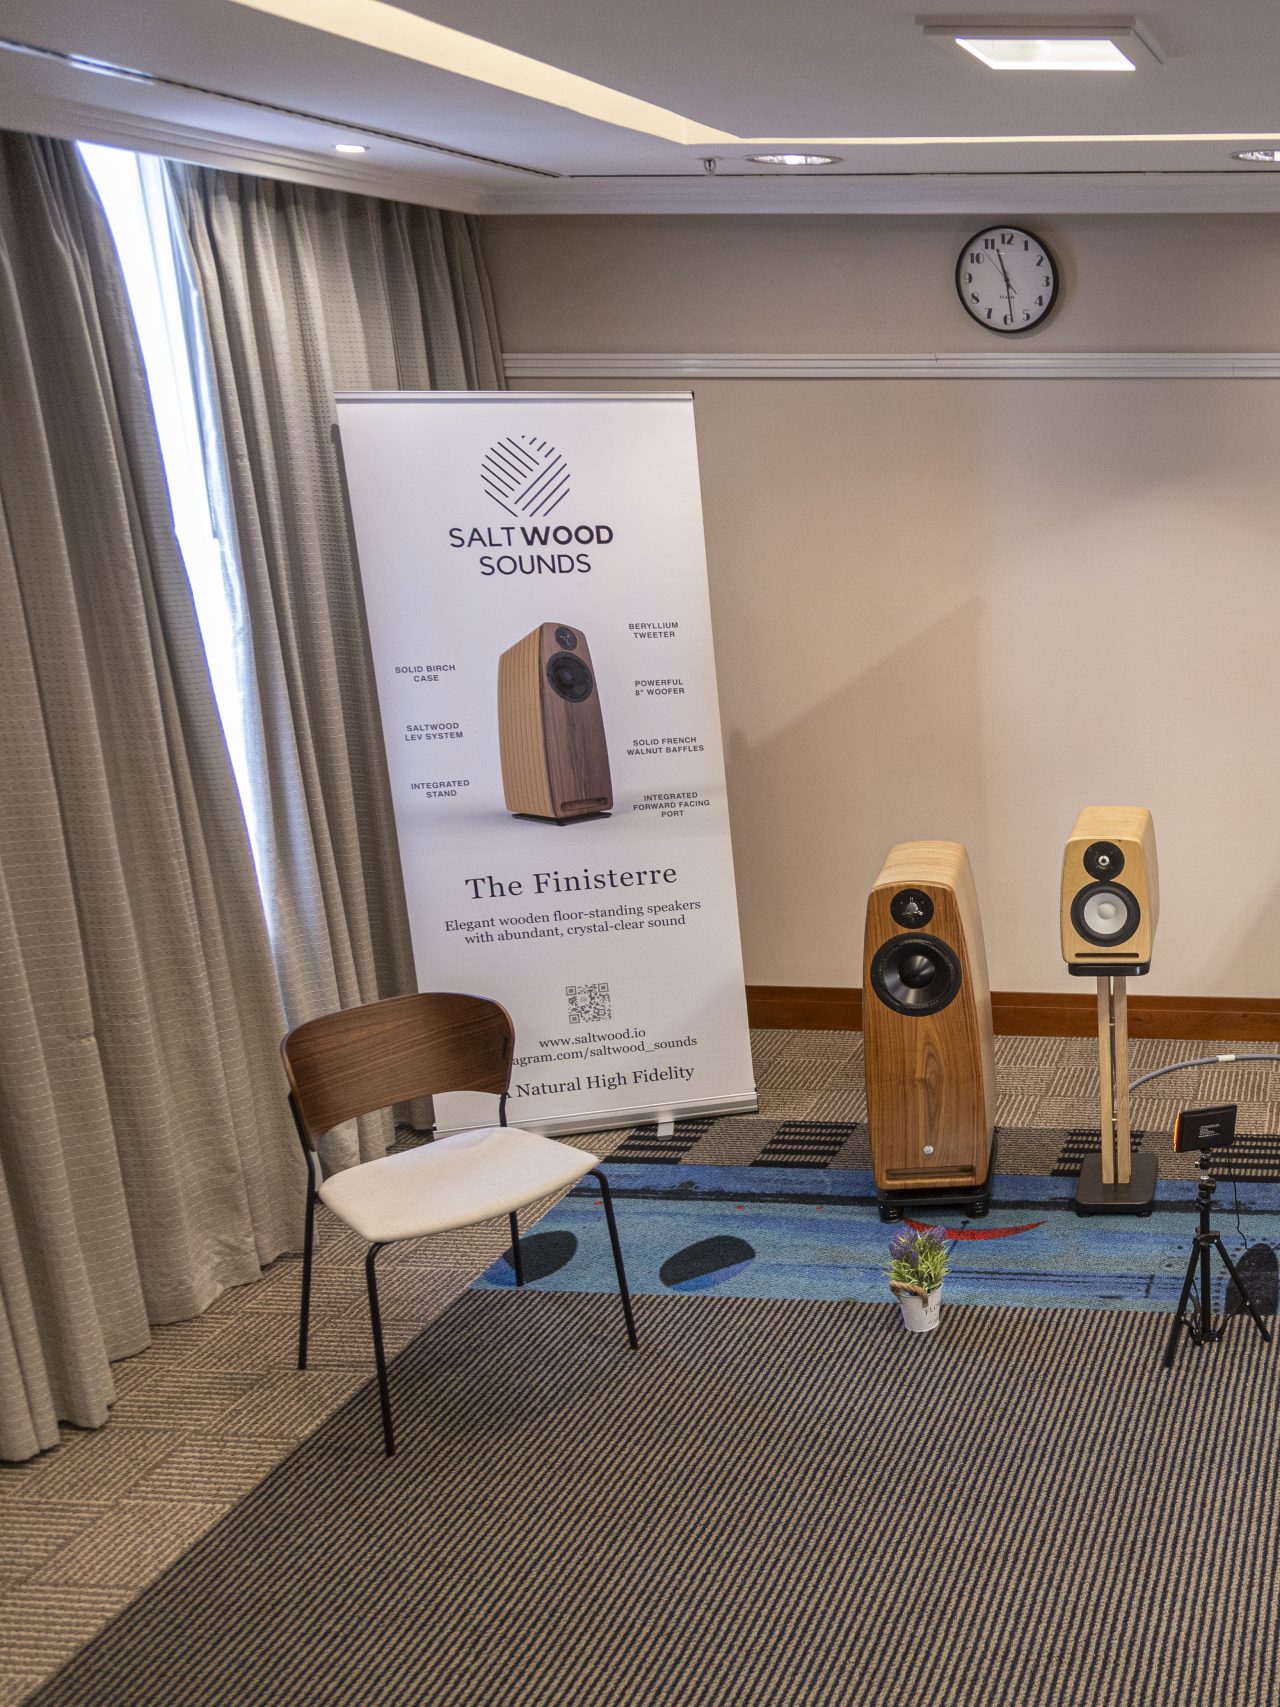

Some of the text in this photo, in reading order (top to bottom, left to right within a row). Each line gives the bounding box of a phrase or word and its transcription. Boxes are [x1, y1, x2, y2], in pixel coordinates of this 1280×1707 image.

[984, 238, 995, 250] 11
[1000, 233, 1014, 245] 12
[1024, 240, 1029, 251] 1
[970, 252, 985, 264] 10
[1036, 255, 1044, 267] 2
[963, 272, 973, 284] 9
[1042, 276, 1050, 287] 3
[971, 292, 980, 304] 8
[1034, 295, 1043, 307] 4
[985, 308, 993, 320] 7
[1003, 313, 1013, 326] 6
[1022, 309, 1031, 321] 5
[480, 553, 591, 575] SOUNDS
[628, 621, 679, 631] BERYLLIUM
[633, 630, 675, 639] TWEETER
[394, 663, 456, 675] SOLID BIRCH
[413, 673, 440, 683] CASE
[634, 678, 684, 688] POWERFUL
[646, 686, 685, 696] WOOFER
[406, 721, 460, 732] SALTWOOD
[404, 730, 464, 742] LEV SYSTEM
[632, 735, 697, 747] SOLID FRENCH
[626, 743, 705, 756] WALNUT BAFFLES
[410, 779, 470, 791] INTEGRATED
[425, 788, 458, 799] STAND
[643, 791, 698, 802] INTEGRATED
[633, 798, 711, 811] FORWARD FACING
[660, 808, 685, 818] PORT
[465, 867, 678, 900] The Finisterre
[444, 900, 701, 932] Elegant wooden floor-standing speakers
[464, 914, 686, 944] with abundant, crystal-clear sound
[539, 1028, 646, 1048] www.saltwood.io
[512, 1036, 698, 1067] agram.com/saltwood_sounds
[515, 1077, 581, 1098] Natural
[586, 1072, 627, 1090] High
[632, 1065, 695, 1084] Fidelity
